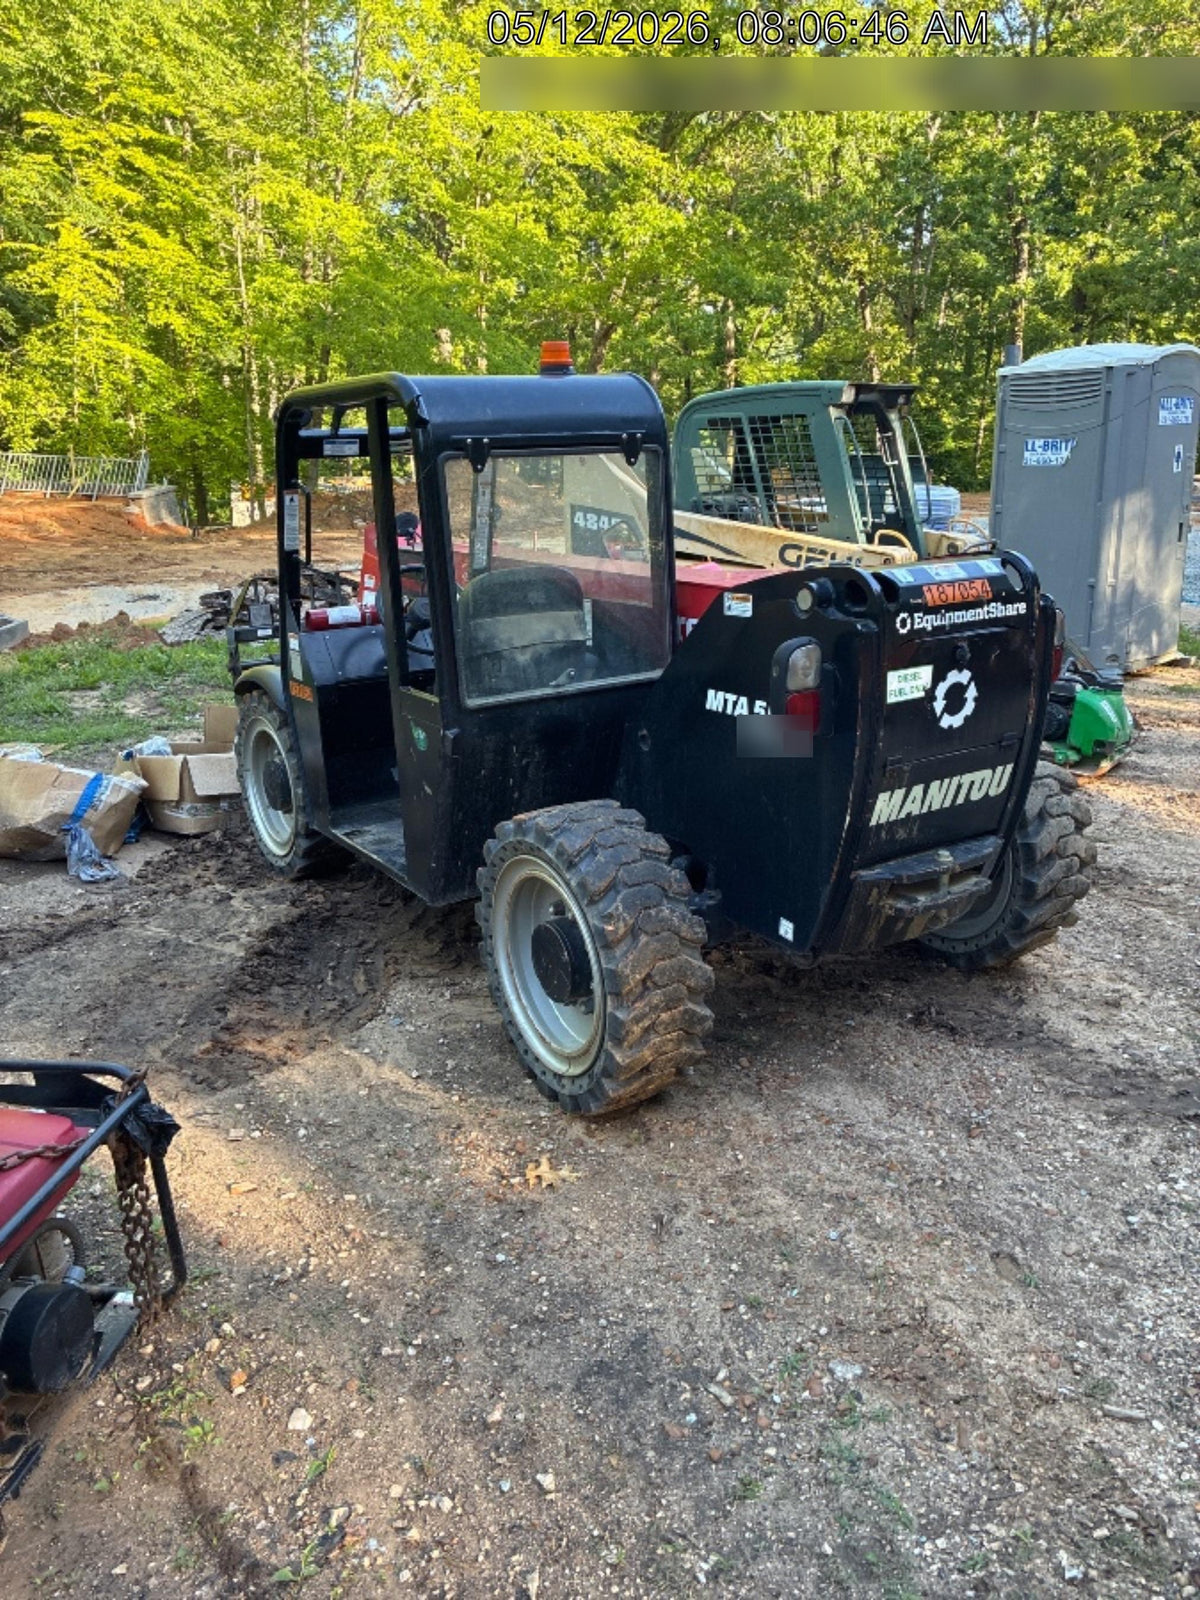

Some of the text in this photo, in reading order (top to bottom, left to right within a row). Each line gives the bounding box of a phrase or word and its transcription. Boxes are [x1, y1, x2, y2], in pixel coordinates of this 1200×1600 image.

[1025, 438, 1076, 453] LL-BRIT
[926, 580, 990, 605] 187054
[913, 602, 1027, 631] EquipmentShare
[897, 671, 923, 684] DIESEL
[705, 690, 750, 717] MTA
[889, 687, 908, 698] FUEL
[869, 763, 1014, 827] MANITOU
